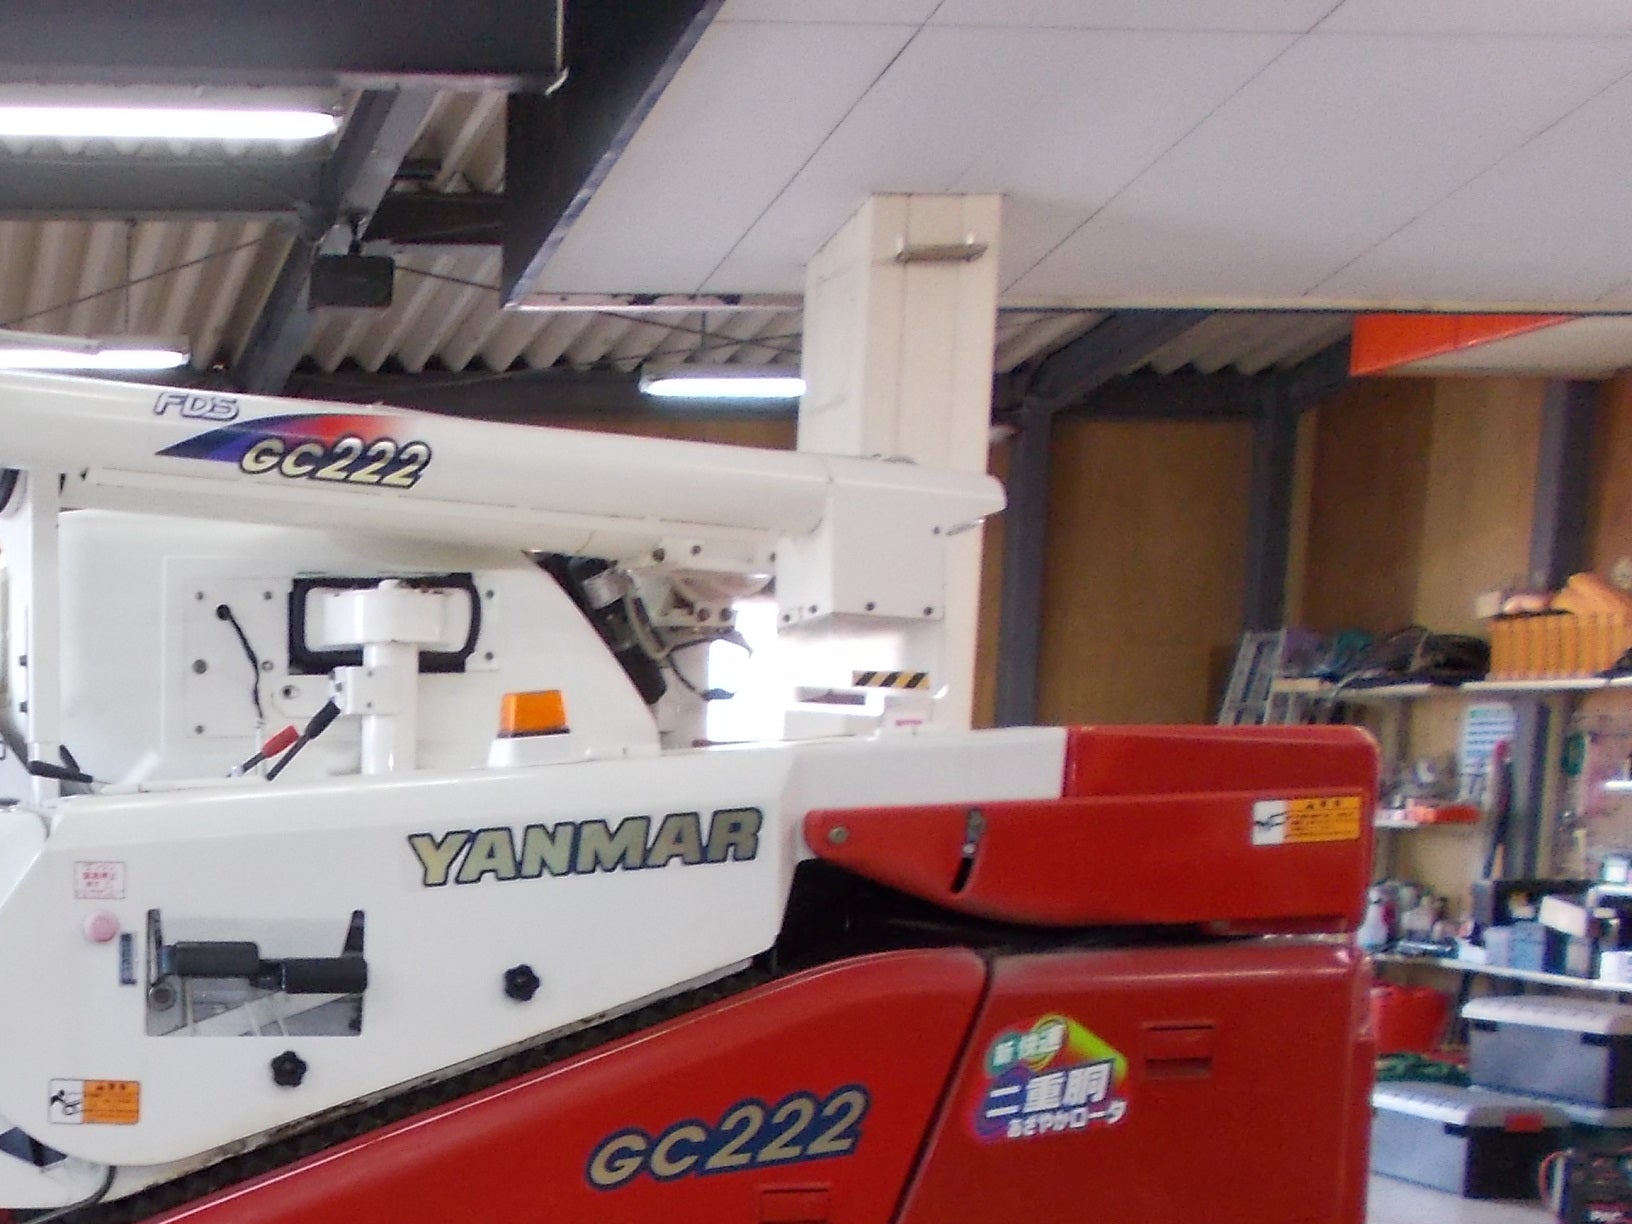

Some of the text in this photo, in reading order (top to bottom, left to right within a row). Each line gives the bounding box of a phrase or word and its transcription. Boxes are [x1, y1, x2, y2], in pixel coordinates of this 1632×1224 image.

[153, 390, 239, 421] FDS
[238, 433, 432, 488] GC222
[407, 806, 764, 888] YANMAR
[585, 1084, 870, 1190] GC222
